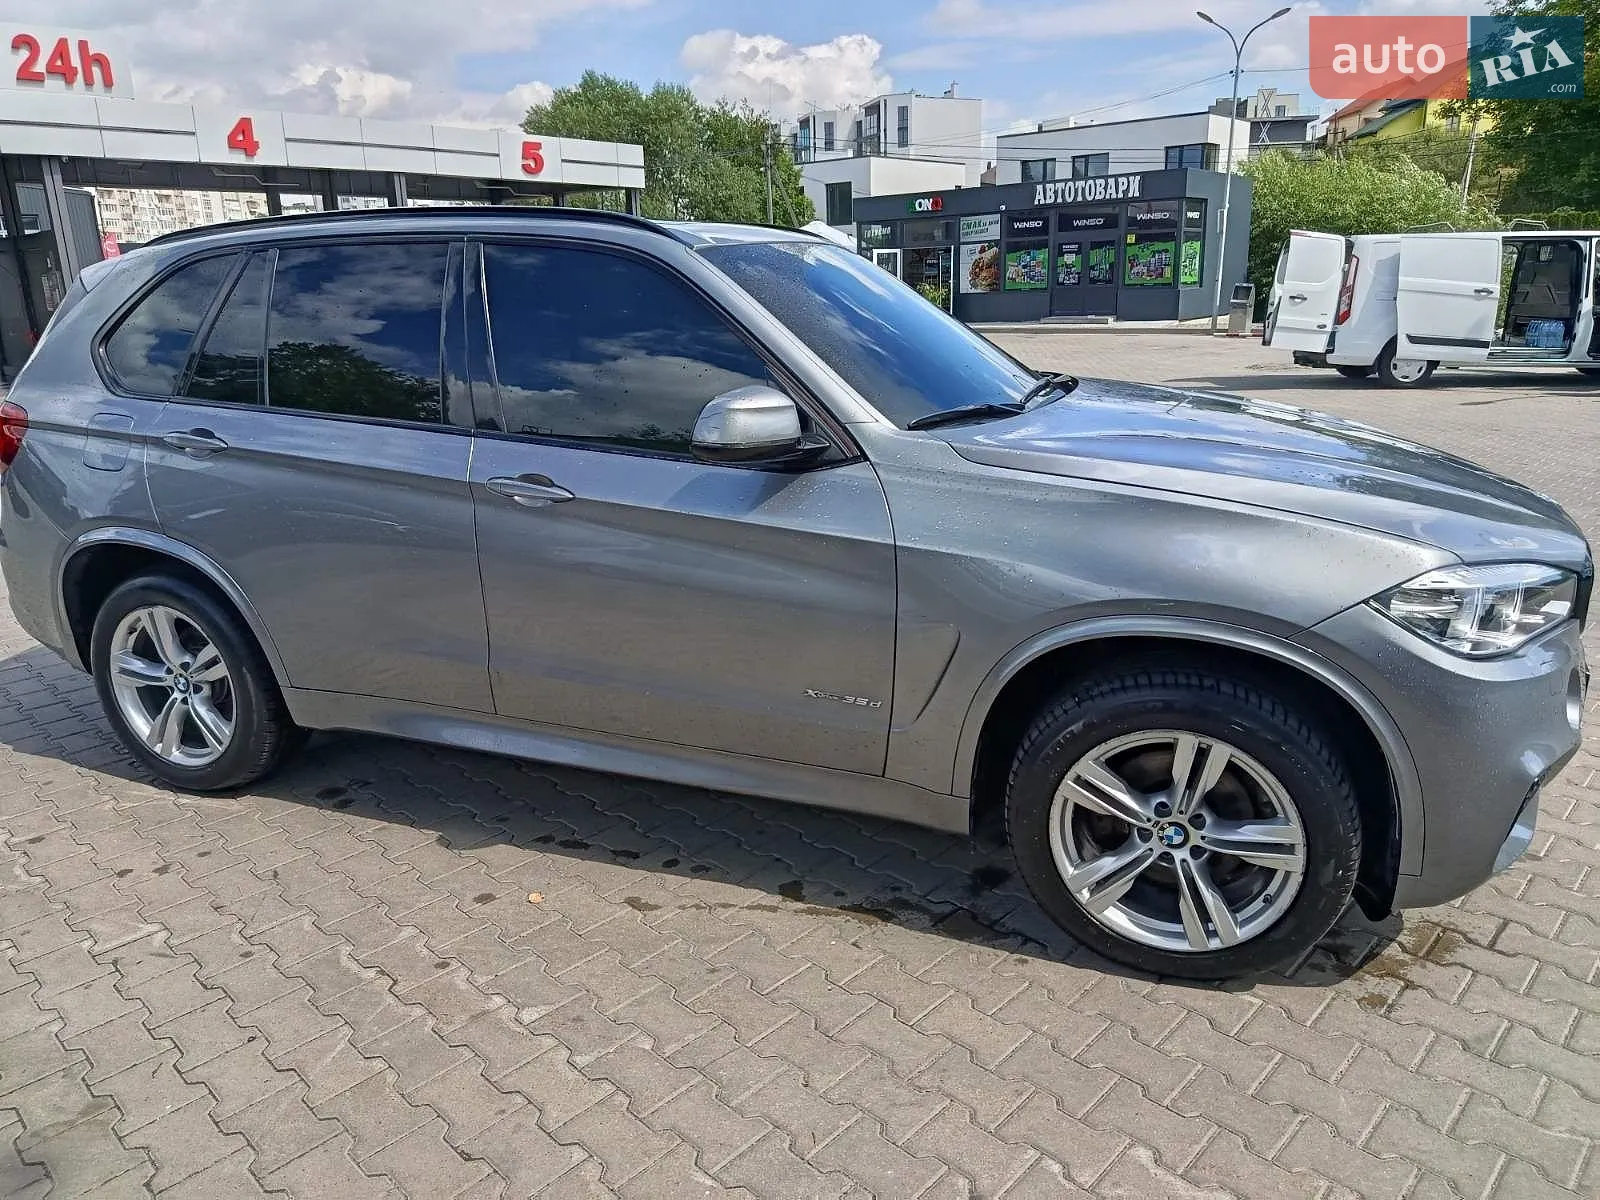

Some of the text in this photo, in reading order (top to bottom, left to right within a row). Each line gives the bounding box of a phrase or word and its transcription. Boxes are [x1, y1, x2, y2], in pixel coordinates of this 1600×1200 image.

[11, 33, 114, 88] 24h
[227, 117, 260, 157] 4
[521, 141, 545, 175] 5
[1034, 175, 1141, 205] АВТОТОВАРИ
[1013, 220, 1043, 229] WINSO
[1073, 217, 1104, 227] WINSO
[1136, 212, 1169, 221] WINSO
